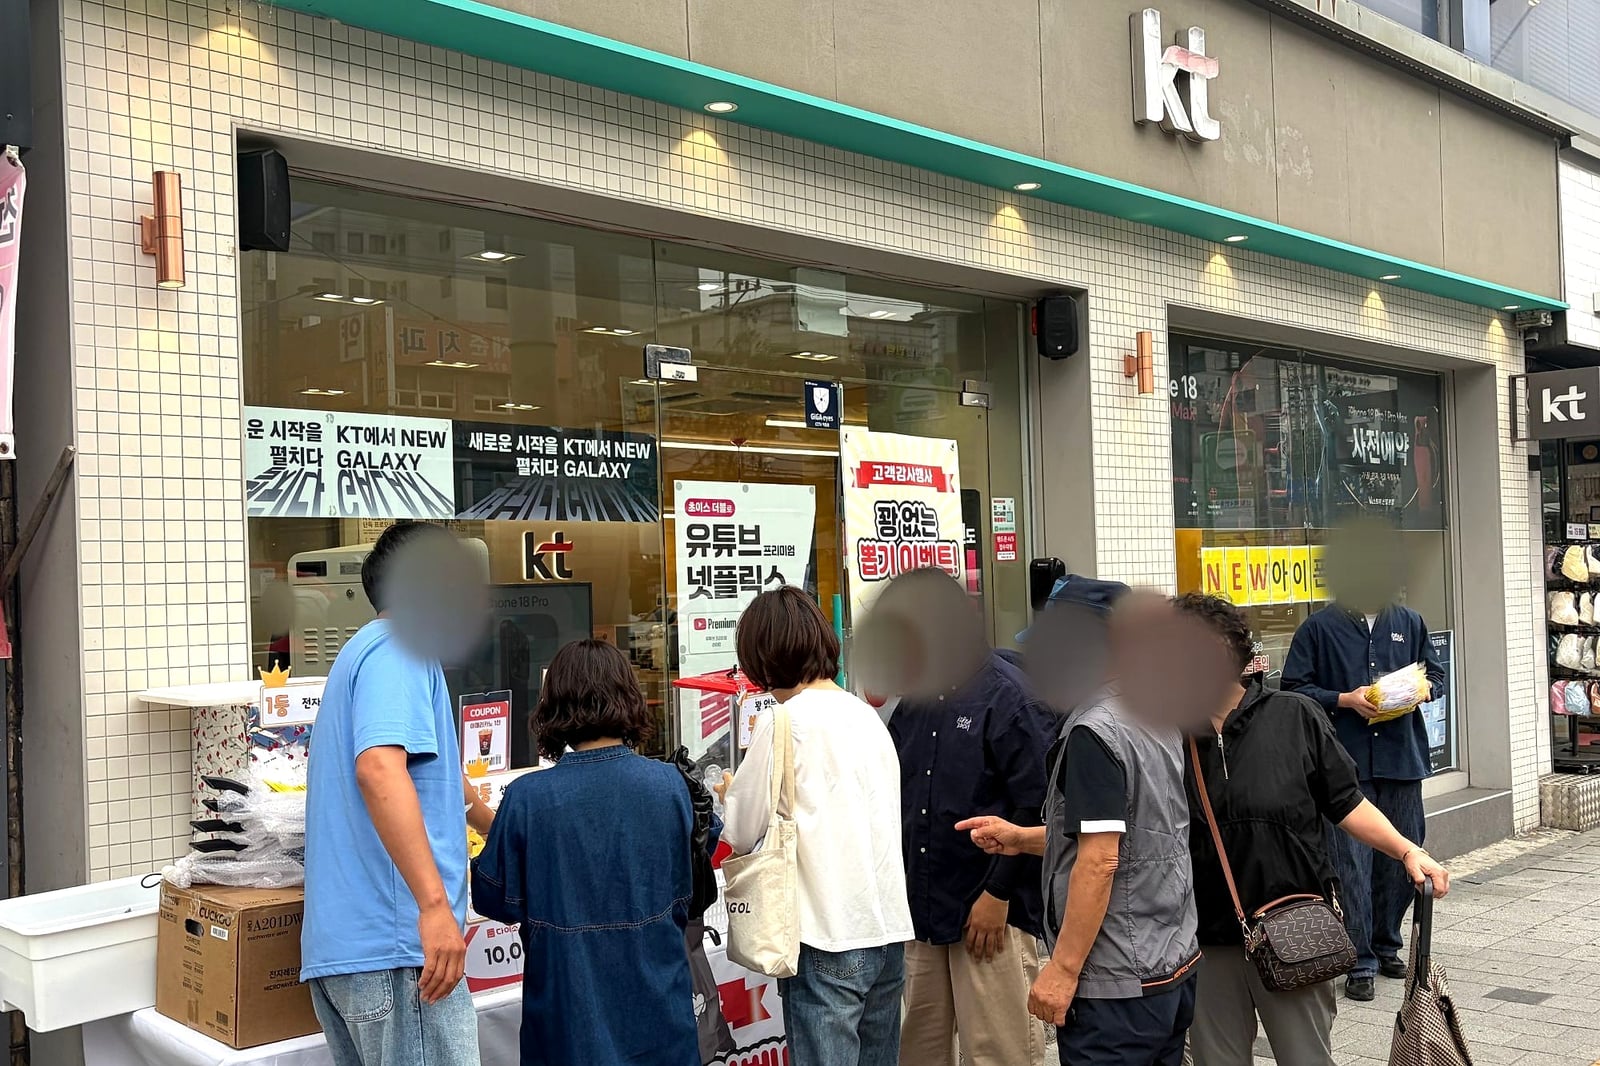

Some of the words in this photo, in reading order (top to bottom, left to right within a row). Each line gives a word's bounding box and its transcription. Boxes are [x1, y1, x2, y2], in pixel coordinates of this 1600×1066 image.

[1130, 8, 1220, 141] kt
[1181, 375, 1198, 400] 18
[1542, 385, 1587, 423] kt
[270, 420, 323, 443] 시작을
[337, 425, 396, 447] KT에서
[401, 429, 447, 449] NEW
[468, 432, 512, 453] 새로운
[516, 435, 559, 455] 시작을
[564, 438, 611, 459] KT에서
[615, 442, 651, 460] NEW
[1351, 427, 1410, 467] 사전예약
[270, 445, 324, 468] 펼치다
[337, 450, 422, 471] GALAXY
[516, 457, 559, 478] 펼치다
[564, 460, 631, 480] GALAXY
[688, 501, 711, 513] 초이스
[901, 504, 938, 539] 없는
[686, 523, 762, 558] 유튜브
[763, 544, 796, 557] 프리미엄
[522, 530, 575, 580] kt
[860, 543, 897, 577] 뽑기
[687, 565, 787, 600] 넷플릭스
[708, 617, 737, 630] Premium
[265, 694, 290, 717] 1등
[470, 706, 501, 718] COUPON
[199, 906, 232, 927] CUCKOO
